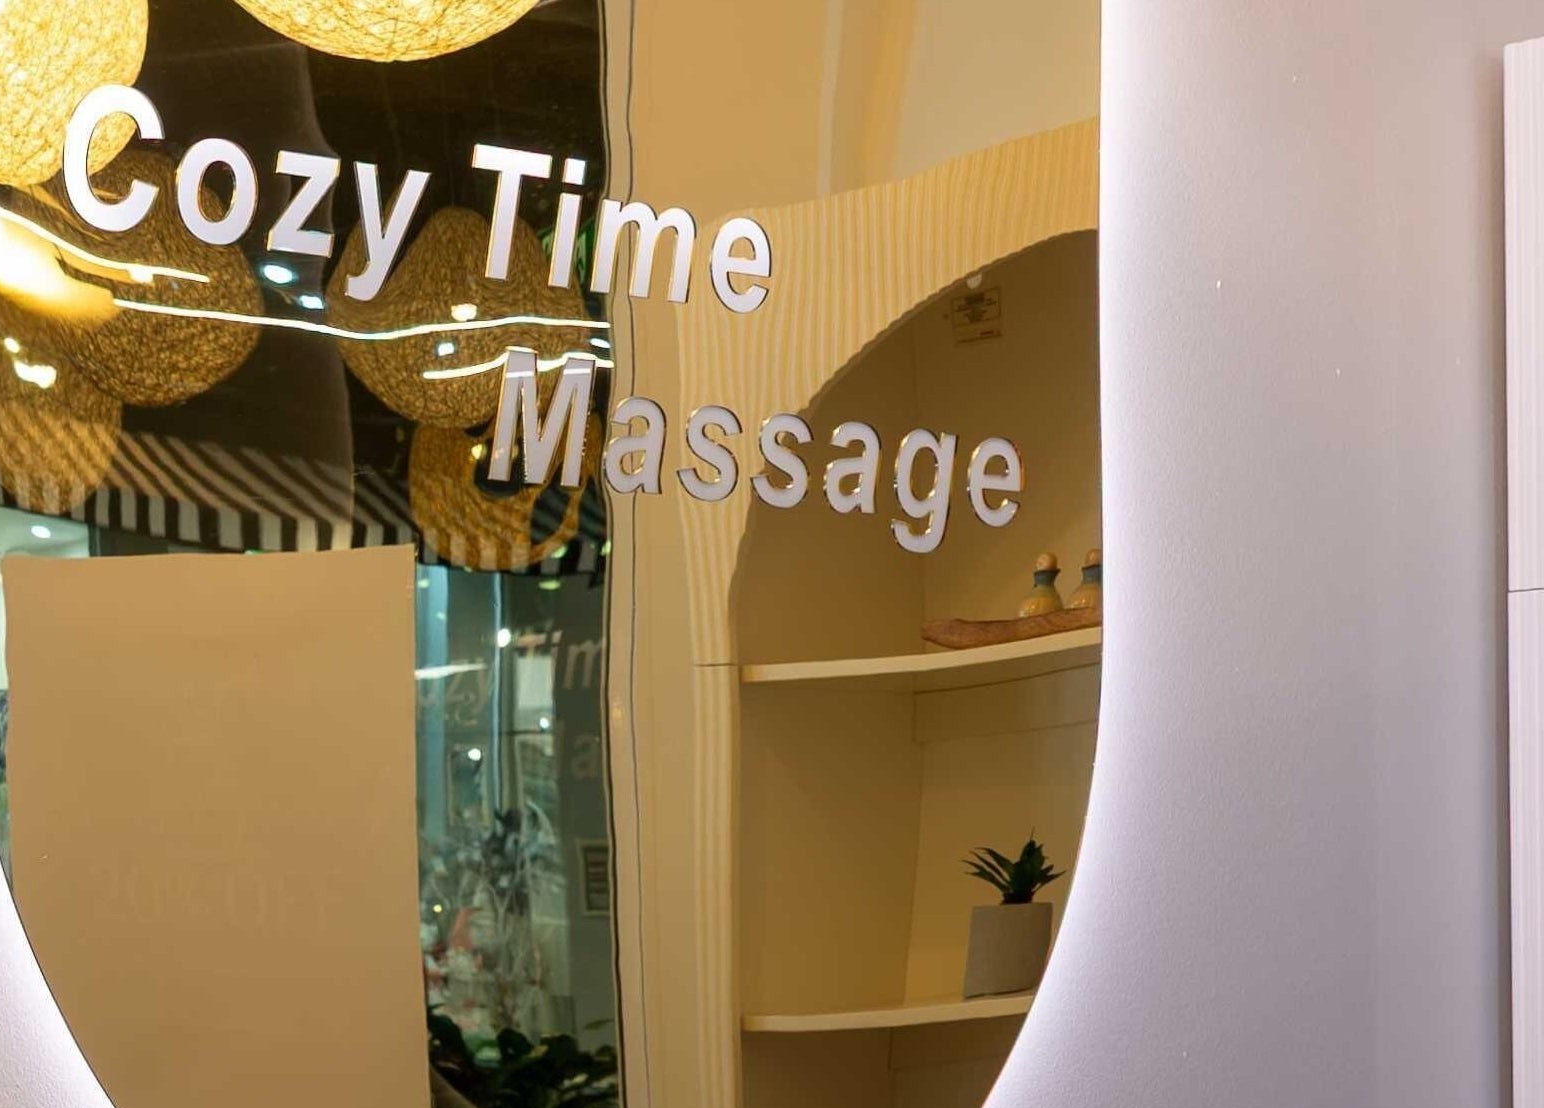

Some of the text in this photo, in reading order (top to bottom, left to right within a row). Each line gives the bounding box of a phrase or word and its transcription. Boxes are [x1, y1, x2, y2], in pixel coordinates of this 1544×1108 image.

[63, 84, 772, 314] Cozy Time
[487, 347, 1025, 553] Massage
